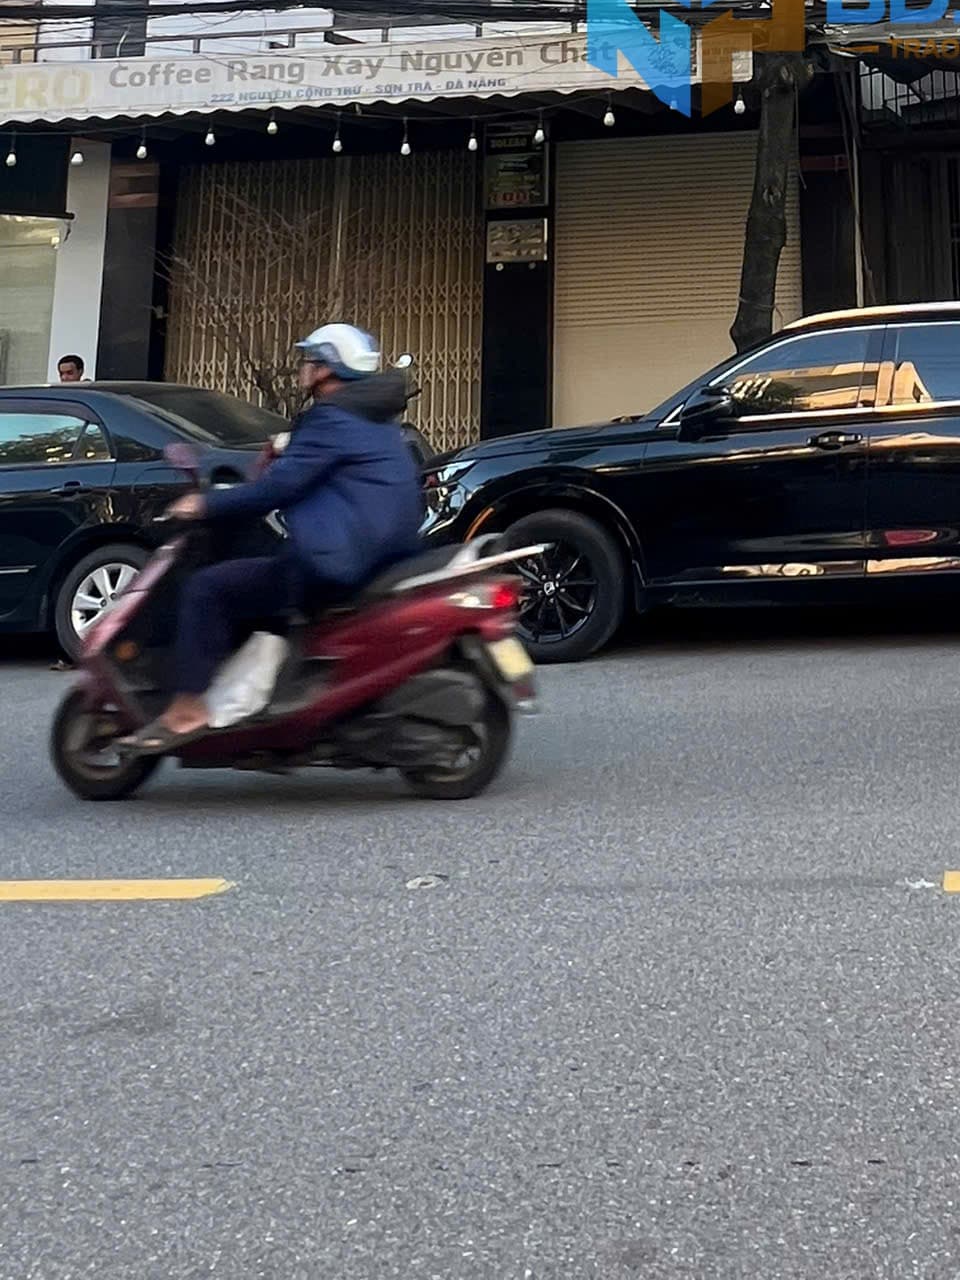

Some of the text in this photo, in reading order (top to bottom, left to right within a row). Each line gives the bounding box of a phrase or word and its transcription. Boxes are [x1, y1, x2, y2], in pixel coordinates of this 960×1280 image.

[109, 62, 212, 88] Coffee
[227, 60, 305, 84] Rang
[321, 54, 385, 80] Xay
[210, 92, 235, 103] 222
